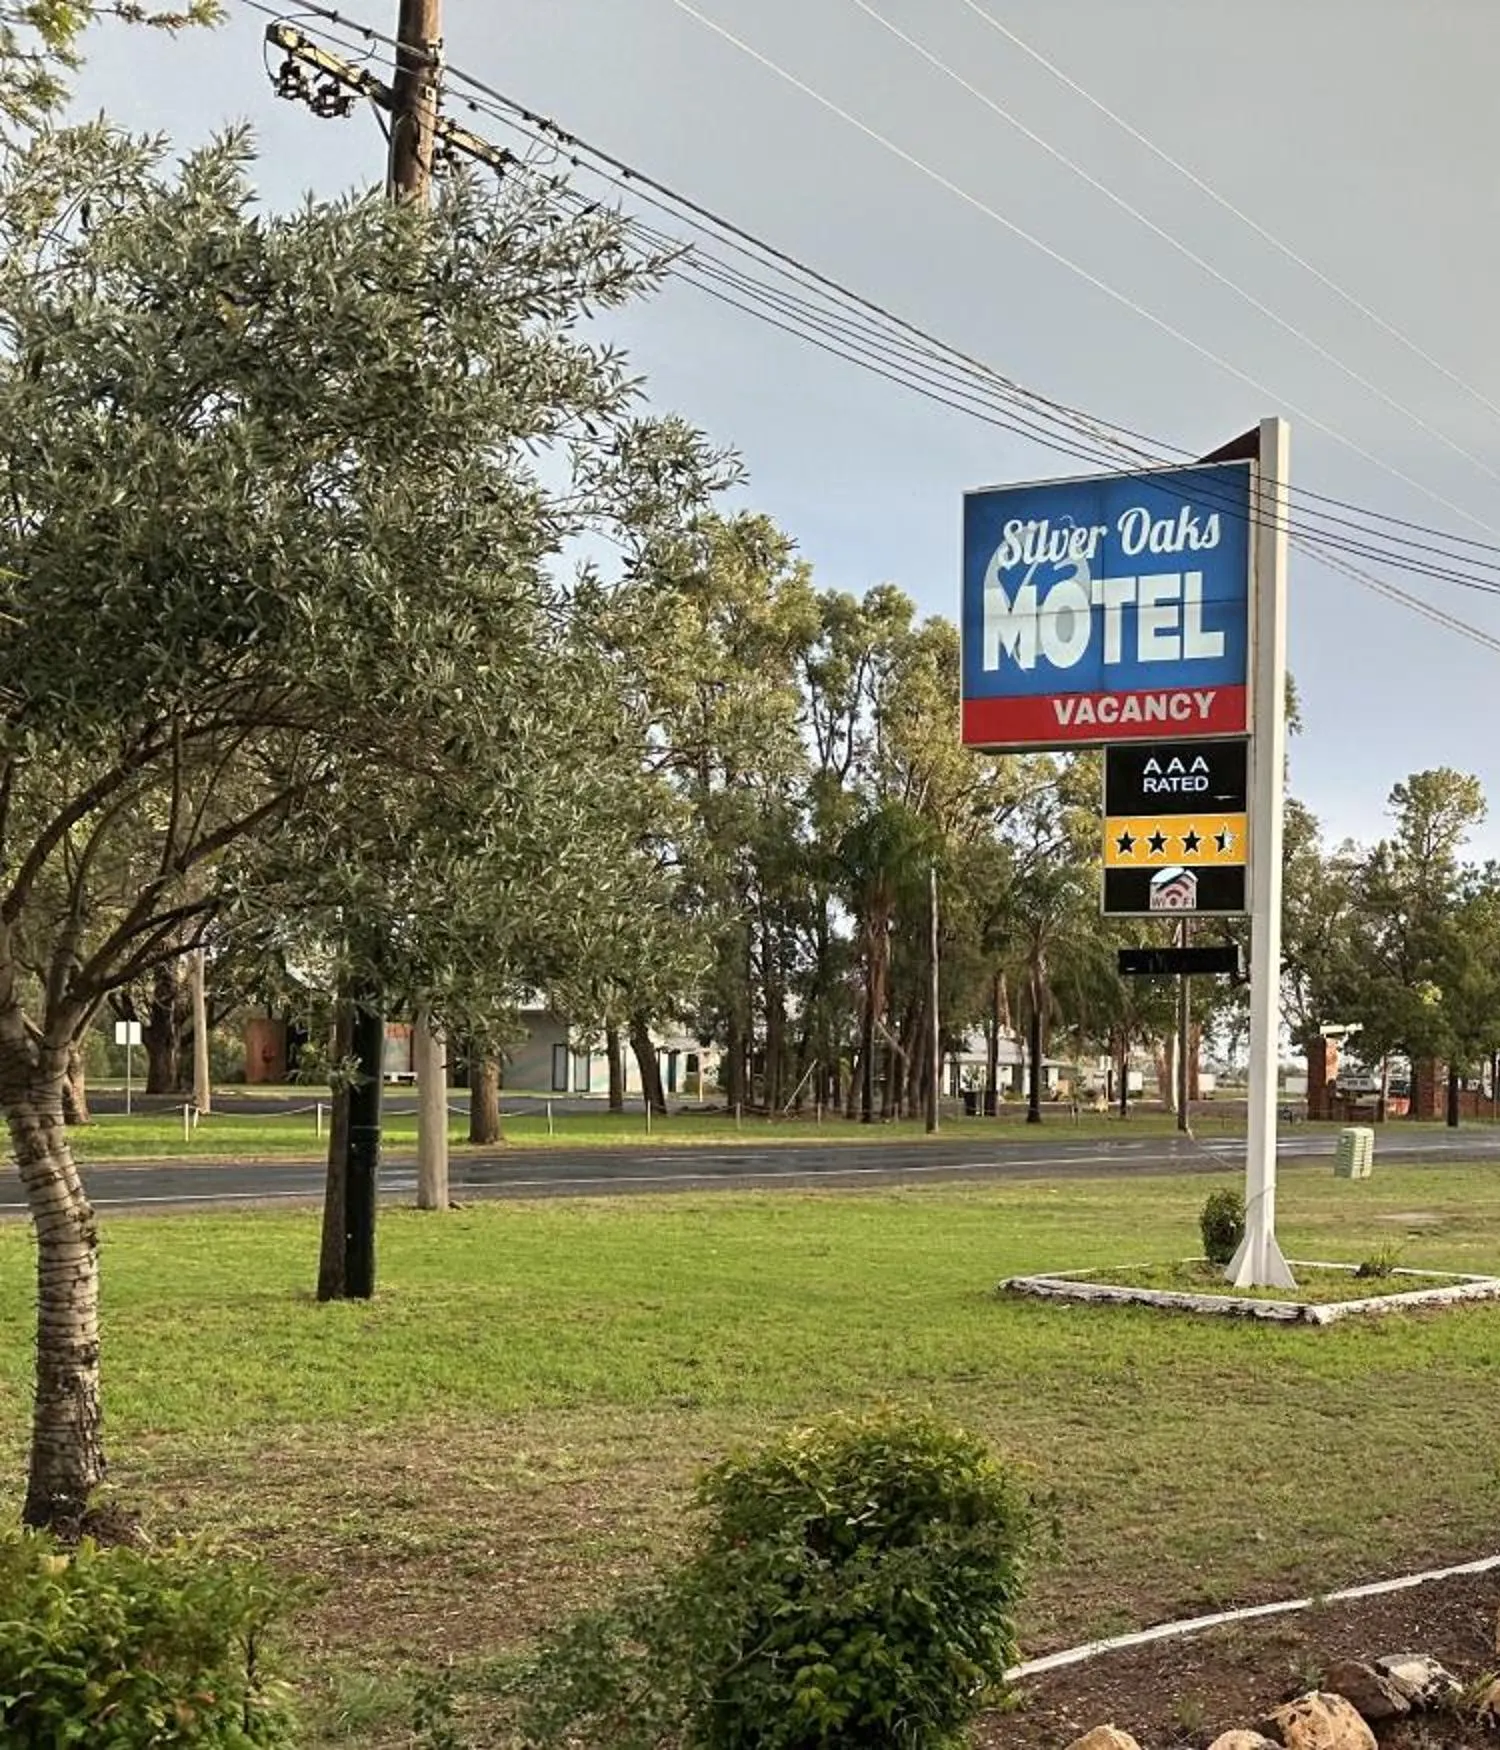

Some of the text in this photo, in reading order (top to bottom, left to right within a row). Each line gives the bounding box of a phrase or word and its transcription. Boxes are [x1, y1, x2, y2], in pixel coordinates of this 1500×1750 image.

[999, 506, 1220, 570] Silver Oaks
[983, 571, 1225, 672] MOTEL
[1053, 692, 1216, 725] VACANCY
[1143, 776, 1209, 793] RATED
